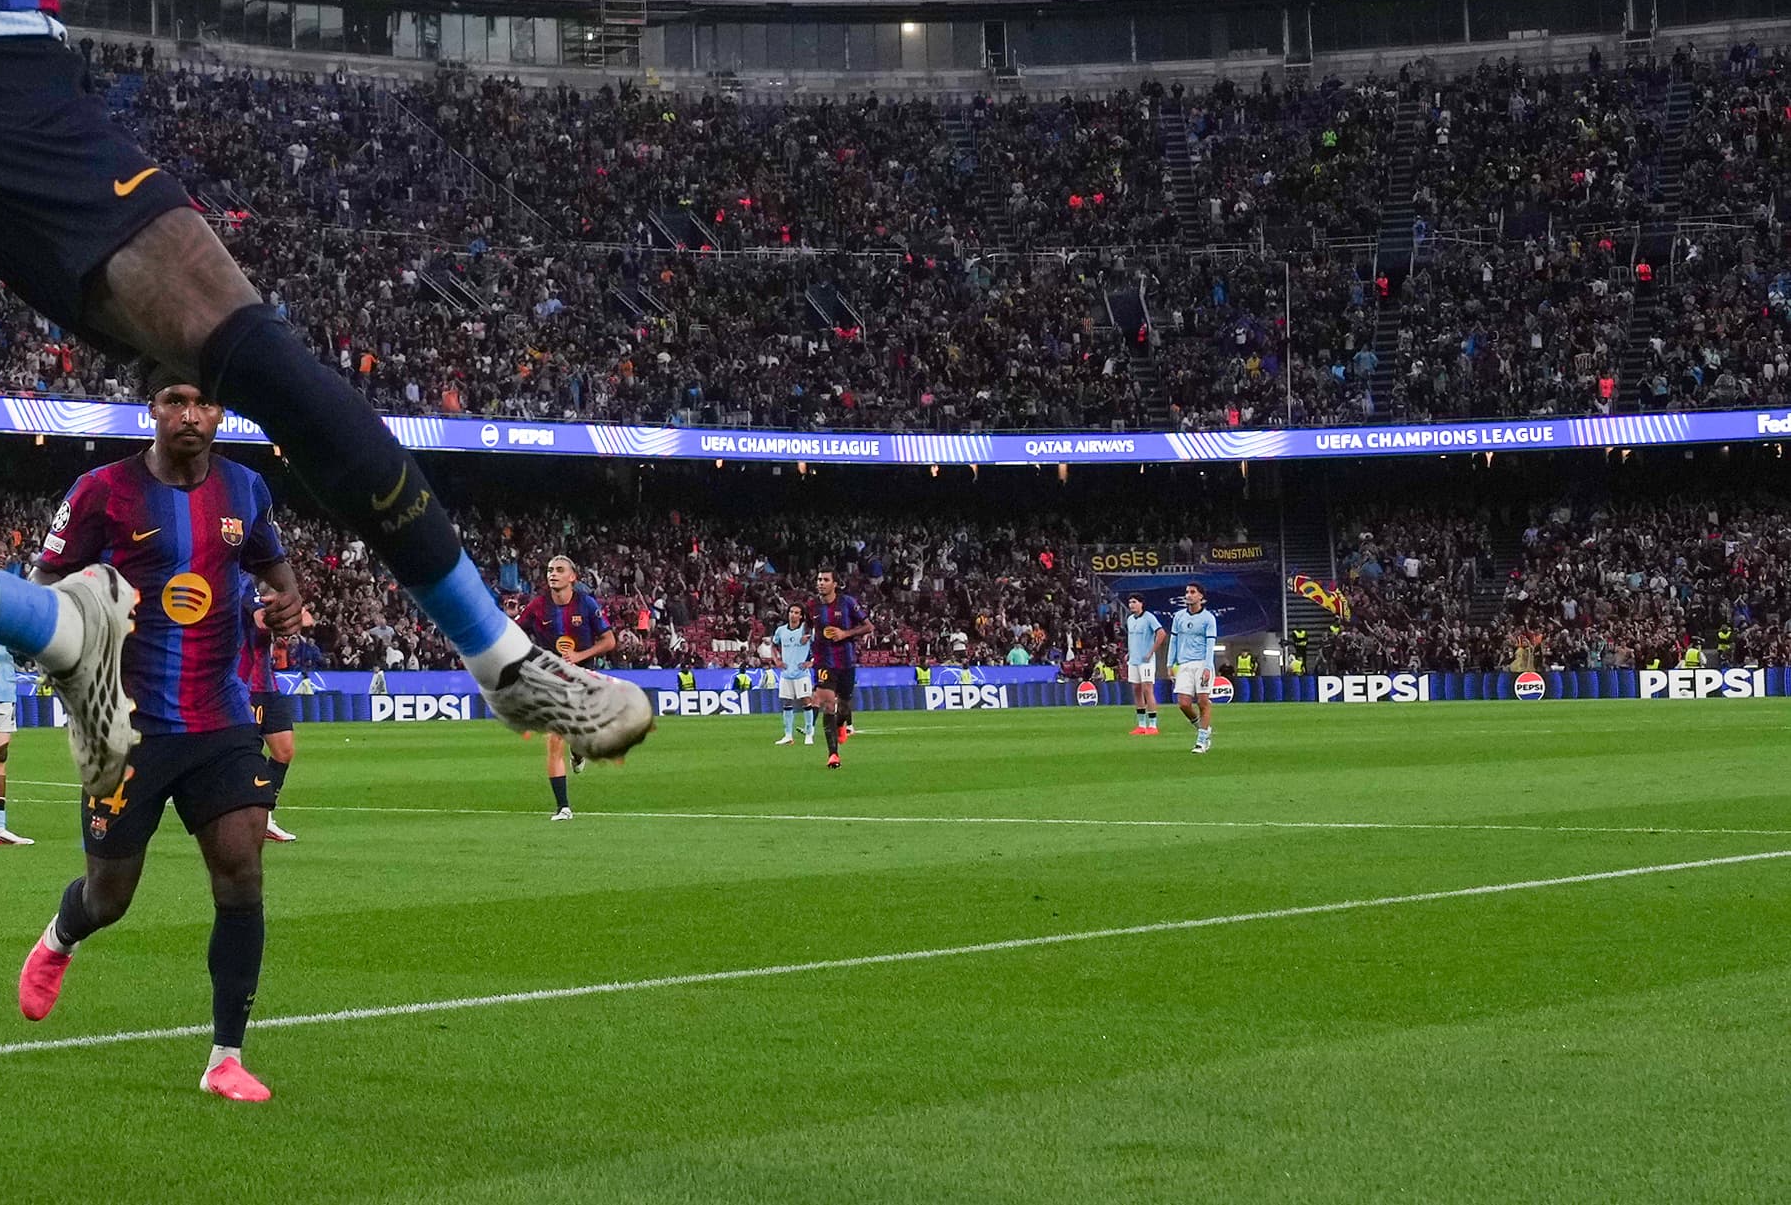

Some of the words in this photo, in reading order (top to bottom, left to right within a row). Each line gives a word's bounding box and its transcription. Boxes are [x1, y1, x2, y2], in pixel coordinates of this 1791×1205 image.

[508, 428, 554, 446] PEPSI
[701, 436, 736, 452] UEFA
[738, 437, 820, 455] CHAMPIONS
[823, 438, 879, 456] LEAGUE
[1025, 440, 1072, 456] QATAR
[1074, 440, 1135, 453] AIRWAYS
[1316, 434, 1363, 450] UEFA
[1366, 429, 1477, 447] CHAMPIONS
[1481, 426, 1554, 444] LEAGUE
[1091, 551, 1159, 571] SOSES
[1318, 673, 1430, 703] PEPSI
[1639, 668, 1765, 699] PEPSI
[371, 694, 470, 721] PEPSI
[658, 690, 750, 716] PEPSI
[925, 685, 1008, 710] PEPSI
